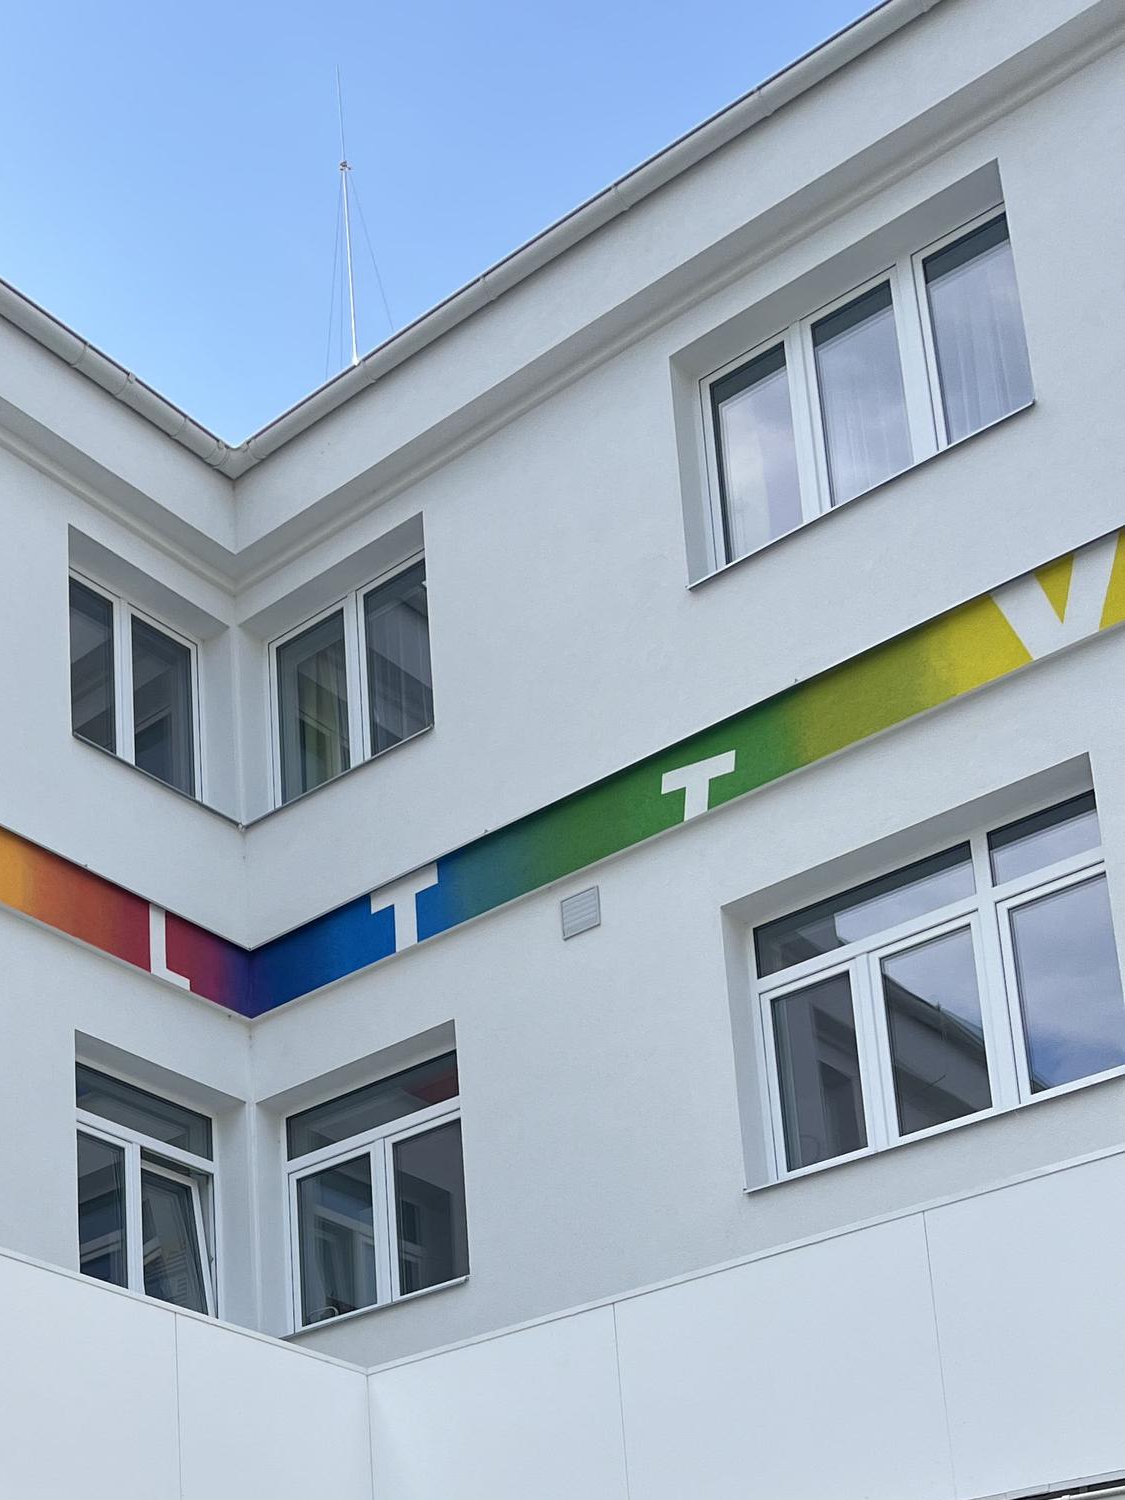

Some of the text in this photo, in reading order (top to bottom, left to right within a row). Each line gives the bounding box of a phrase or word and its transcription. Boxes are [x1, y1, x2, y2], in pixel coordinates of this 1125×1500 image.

[990, 530, 1123, 661] V
[370, 749, 736, 953] T T
[149, 901, 191, 991] L
